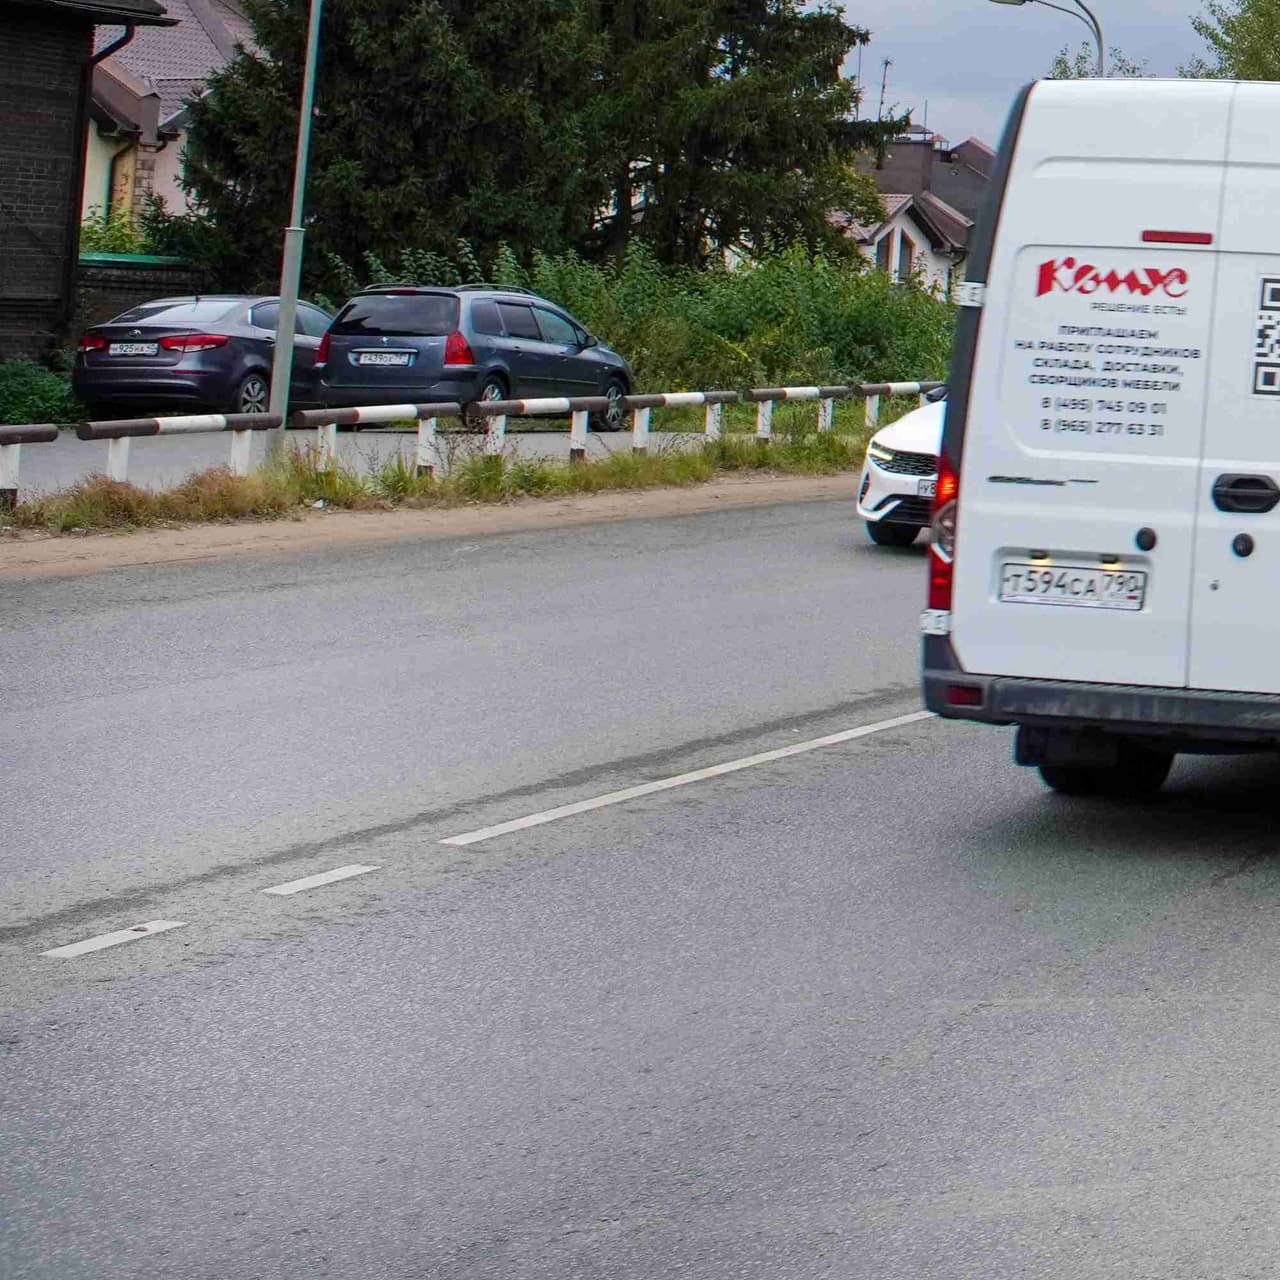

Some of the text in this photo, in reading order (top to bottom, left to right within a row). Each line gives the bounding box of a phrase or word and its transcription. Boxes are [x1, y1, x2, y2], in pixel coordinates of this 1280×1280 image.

[1058, 325, 1160, 340] ПРИГЛАШАЕМ
[1014, 339, 1201, 359] НА РАБОТУ СОТРУДНИКОВ
[1029, 374, 1182, 392] СБОРЩИКОВ МЕБЕЛИ
[1041, 396, 1052, 409] 8
[1055, 396, 1094, 412] (495)
[1040, 418, 1052, 431] 8
